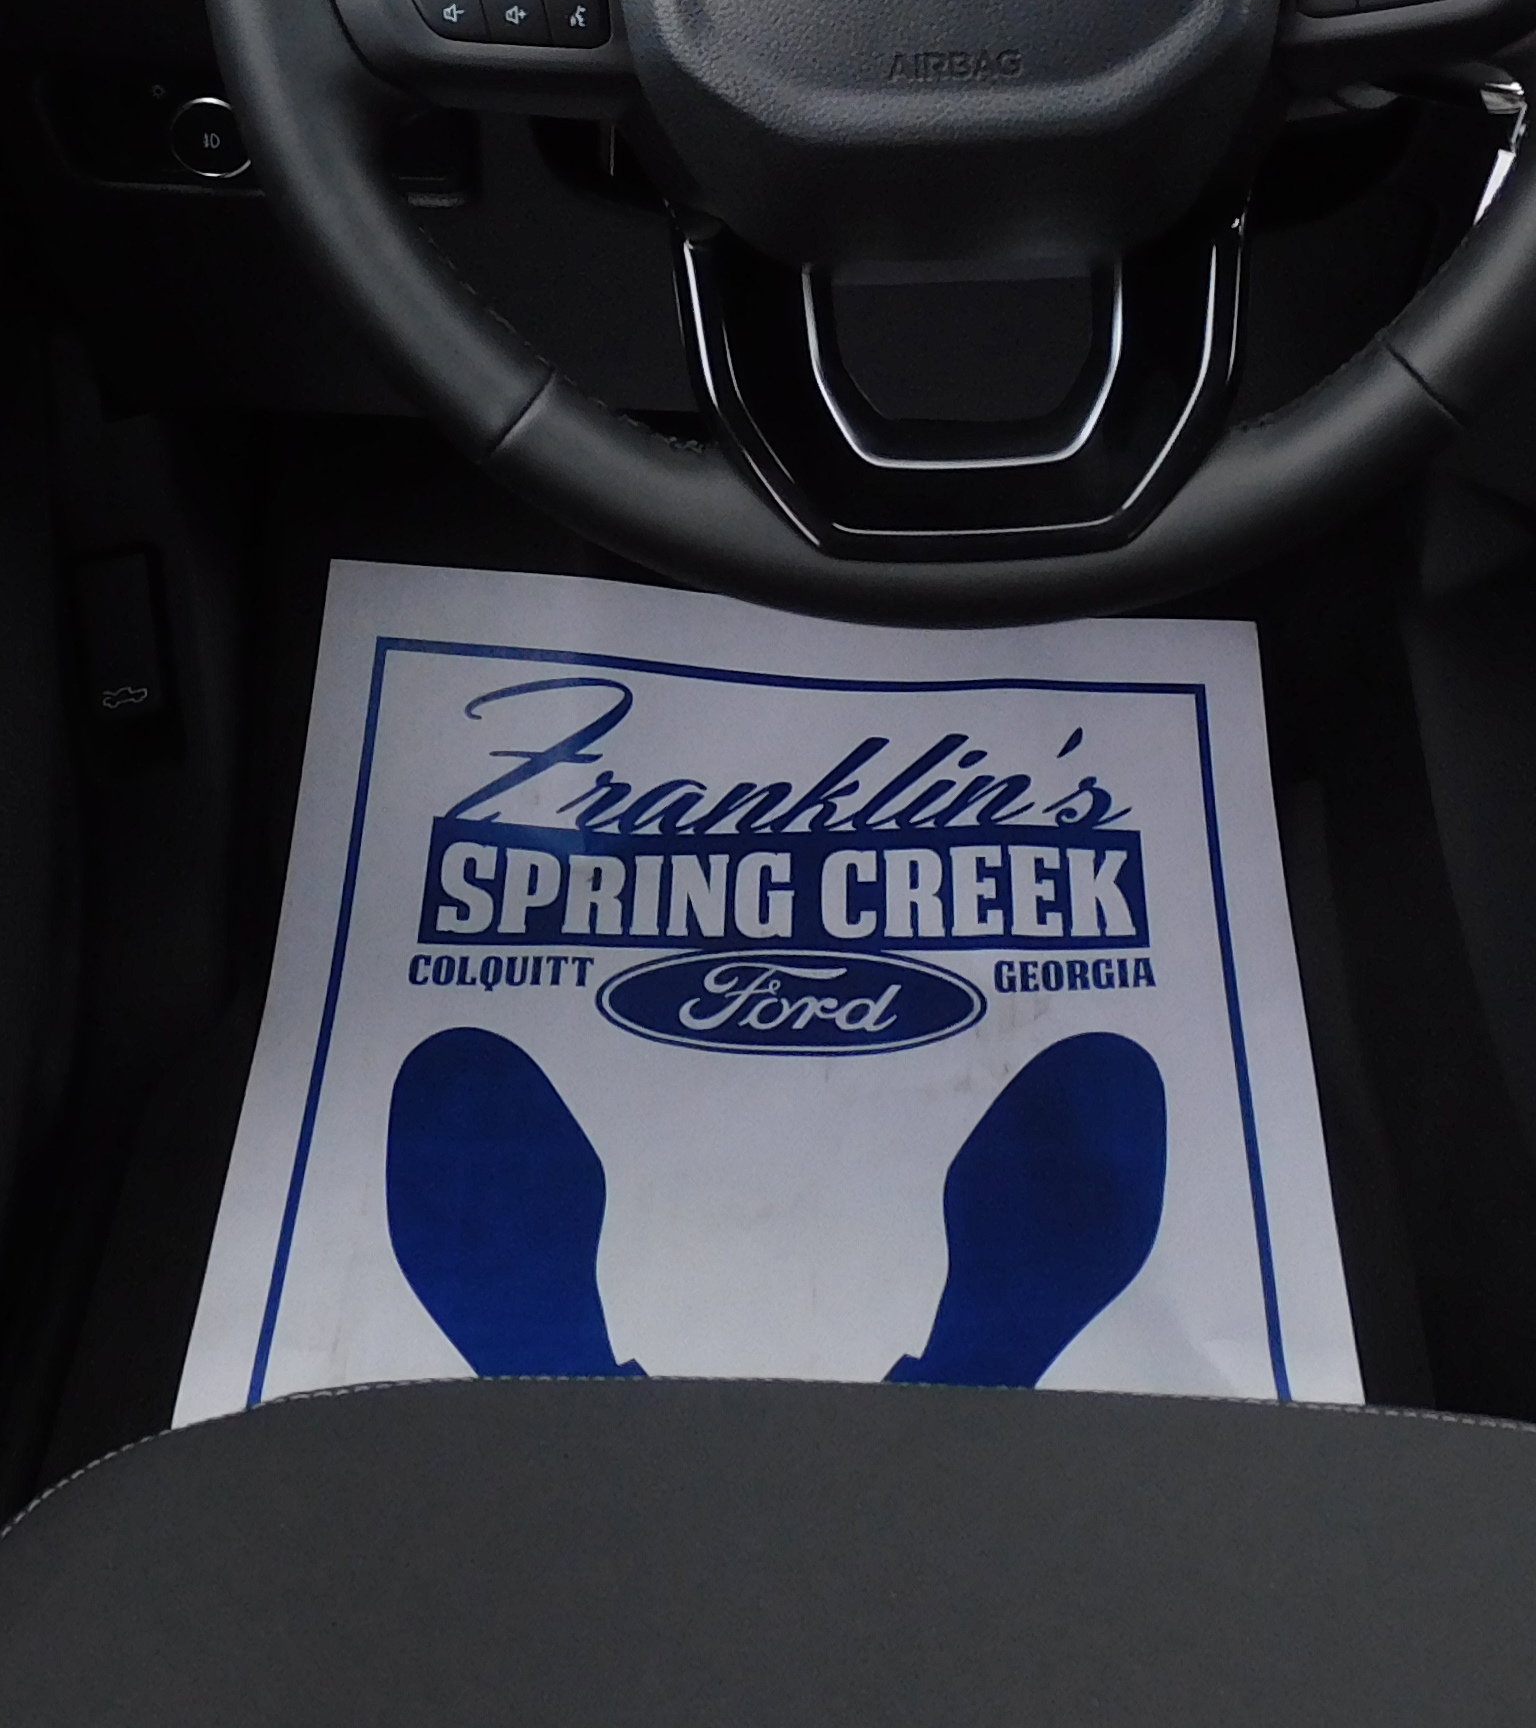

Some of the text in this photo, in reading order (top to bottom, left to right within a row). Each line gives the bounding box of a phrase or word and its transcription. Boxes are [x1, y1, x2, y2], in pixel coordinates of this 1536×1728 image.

[888, 48, 1024, 82] AIRBAG
[444, 677, 1131, 834] Franklin's
[433, 840, 1140, 940] SPRING CREEK
[407, 953, 595, 992] COLQUITT
[678, 964, 898, 1032] Ford
[994, 956, 1157, 994] GEORGIA
